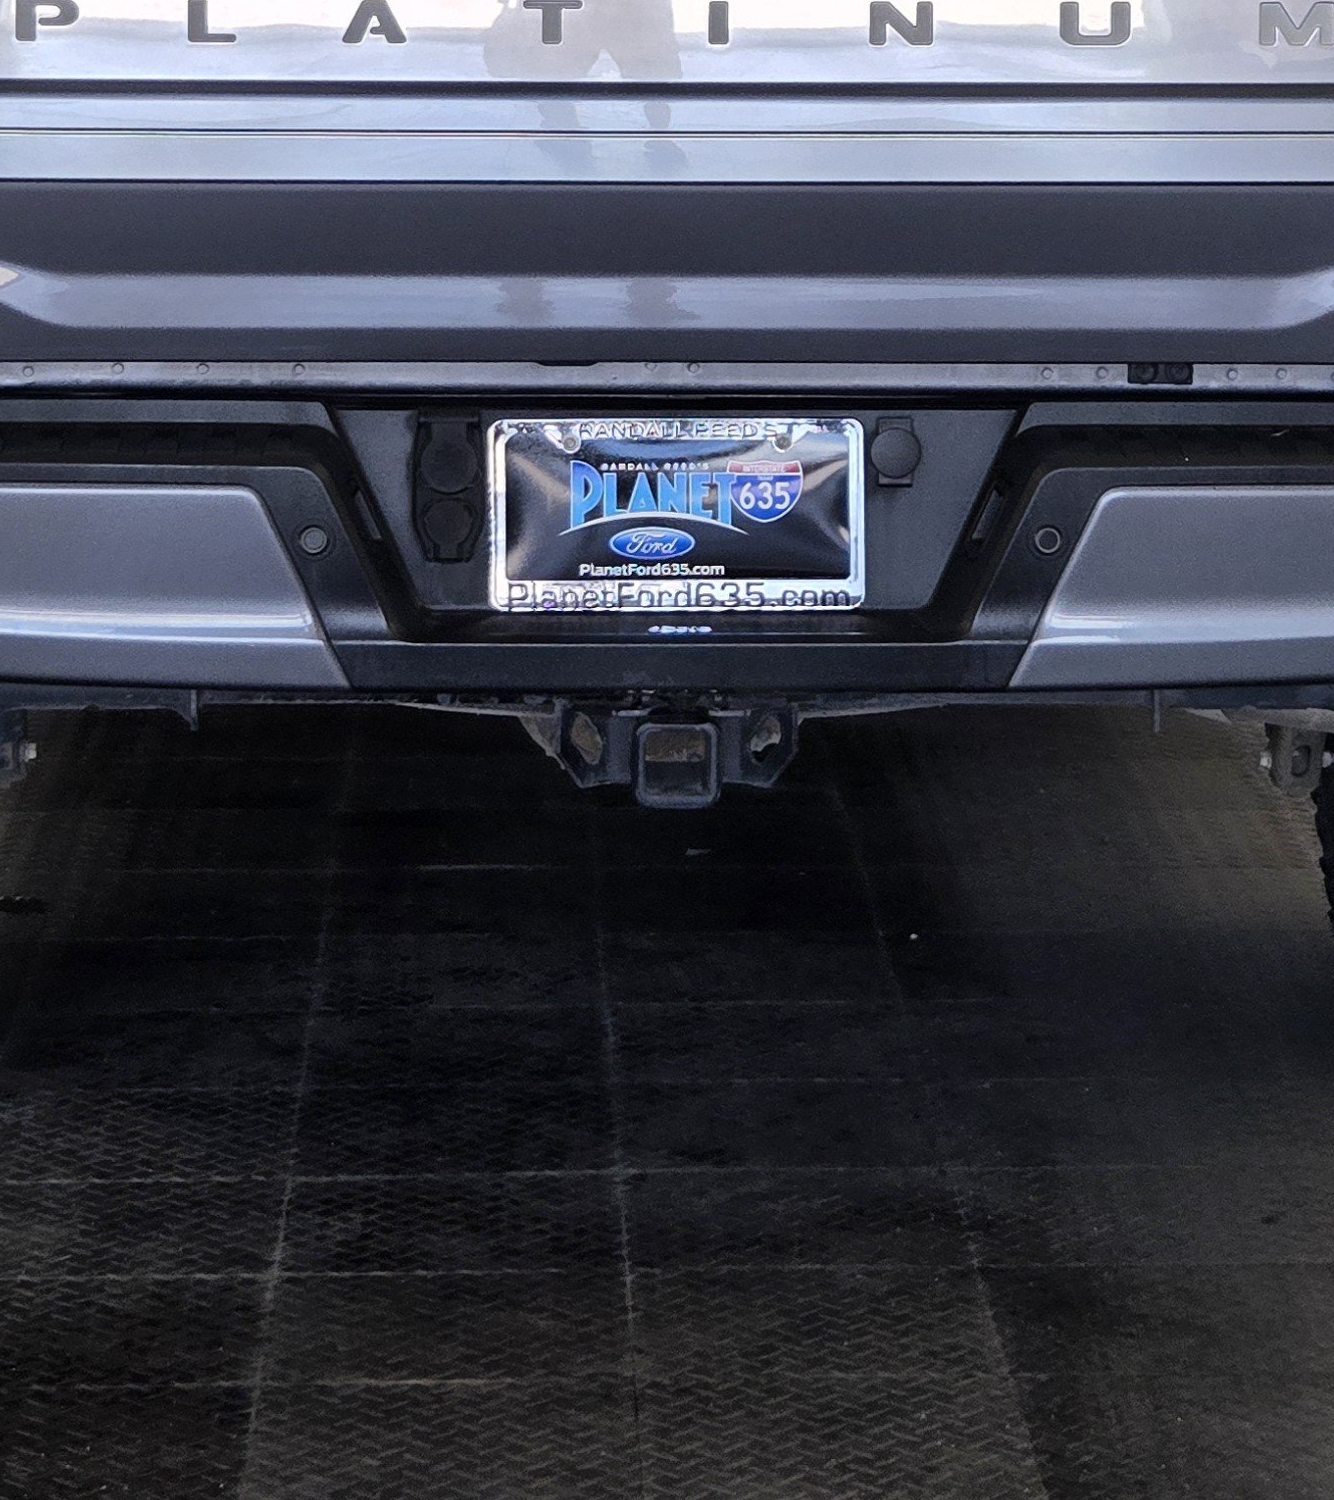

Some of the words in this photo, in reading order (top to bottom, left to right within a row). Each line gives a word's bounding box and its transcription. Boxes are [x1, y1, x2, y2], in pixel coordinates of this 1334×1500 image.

[578, 420, 689, 439] RANDALL
[570, 460, 736, 528] PLANET
[740, 481, 791, 510] 635
[625, 531, 678, 555] Ford
[579, 563, 725, 577] PlanetFord635.com
[507, 581, 851, 609] PlanetFord635.com
